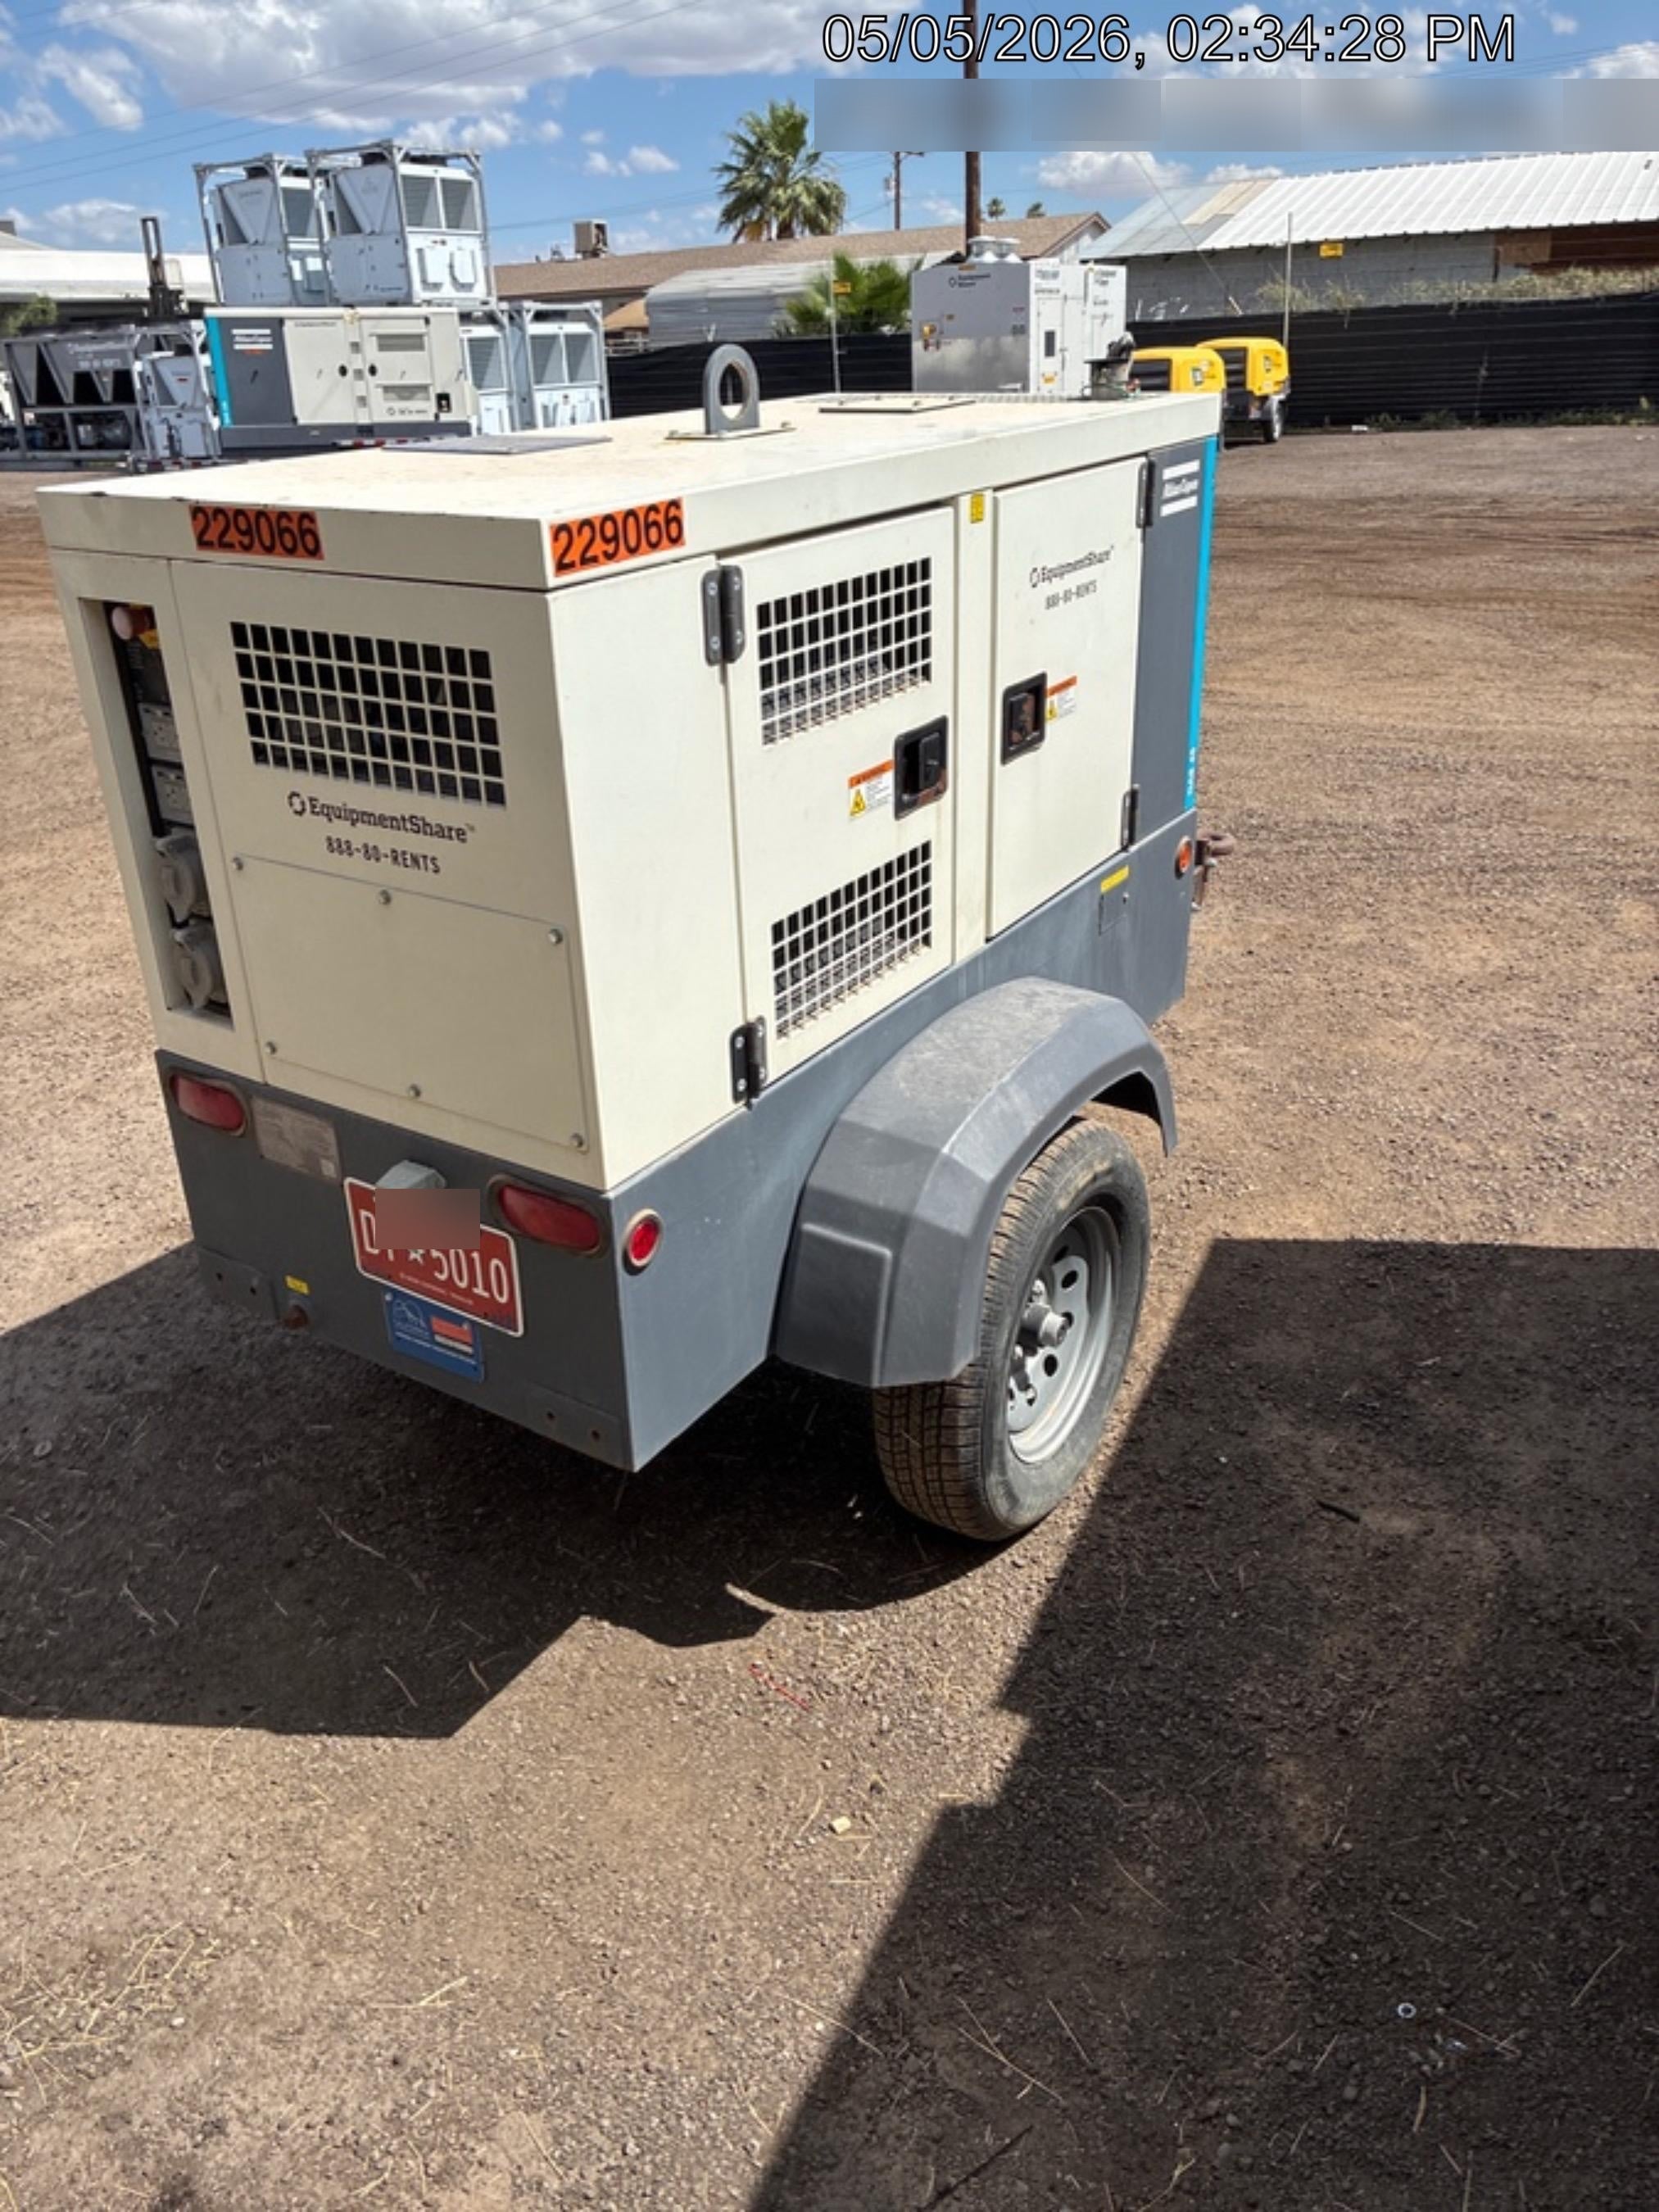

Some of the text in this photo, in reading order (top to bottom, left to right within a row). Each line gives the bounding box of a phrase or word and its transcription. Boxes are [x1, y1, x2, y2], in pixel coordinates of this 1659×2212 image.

[191, 505, 322, 558] 229066
[553, 501, 684, 573] 229066
[307, 795, 469, 844] EquipmentShare
[324, 834, 442, 874] 888-80-RENTS
